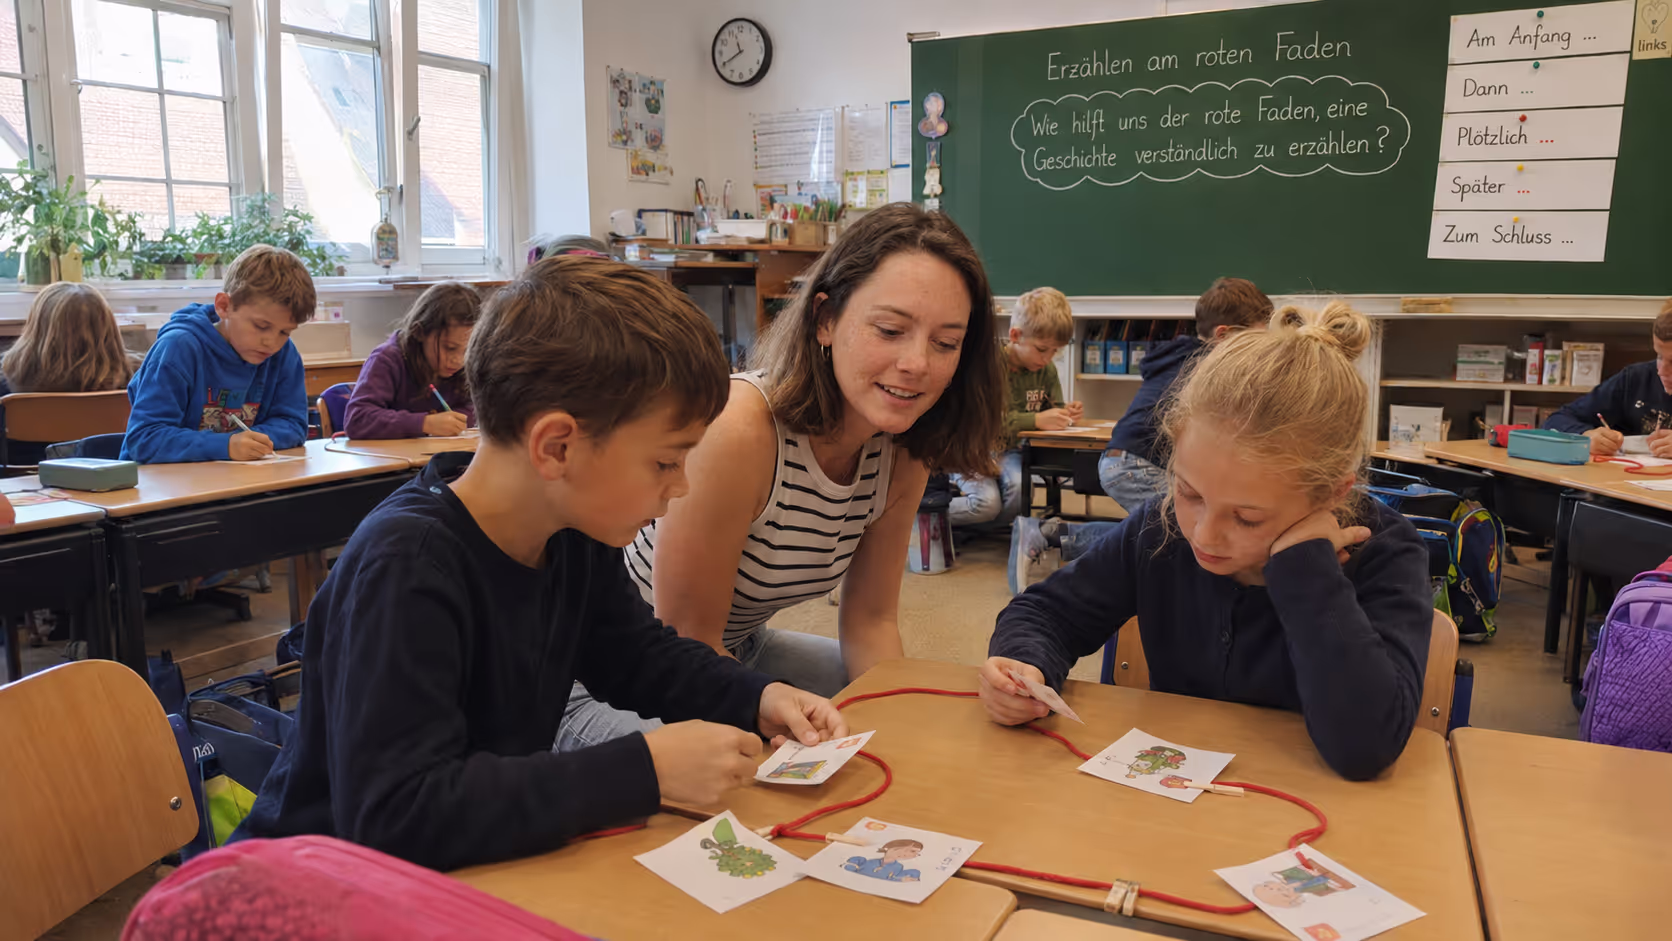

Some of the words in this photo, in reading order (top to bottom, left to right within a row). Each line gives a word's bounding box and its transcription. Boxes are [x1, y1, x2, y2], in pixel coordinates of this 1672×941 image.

[1466, 28, 1496, 49] Am
[1508, 24, 1571, 50] Anfang
[1637, 38, 1668, 53] links
[1047, 48, 1133, 81] Erzählen
[1147, 54, 1179, 71] am
[1195, 38, 1253, 67] roten
[1275, 30, 1352, 61] Faden
[1462, 78, 1509, 98] Dann
[1030, 113, 1059, 137] Wie
[1072, 109, 1105, 141] hilft
[1118, 115, 1148, 131] uns
[1159, 104, 1190, 128] der
[1204, 100, 1242, 125] rote
[1258, 95, 1320, 123] Faden,
[1327, 99, 1368, 119] eine
[1457, 125, 1529, 146] Plötzlich
[1033, 143, 1117, 171] Geschichte
[1134, 136, 1238, 165] verständlich
[1253, 143, 1275, 158] zu
[1288, 130, 1370, 157] erzählen
[1450, 175, 1506, 202] Später
[1442, 224, 1479, 243] Zum
[1491, 225, 1552, 244] Schluss
